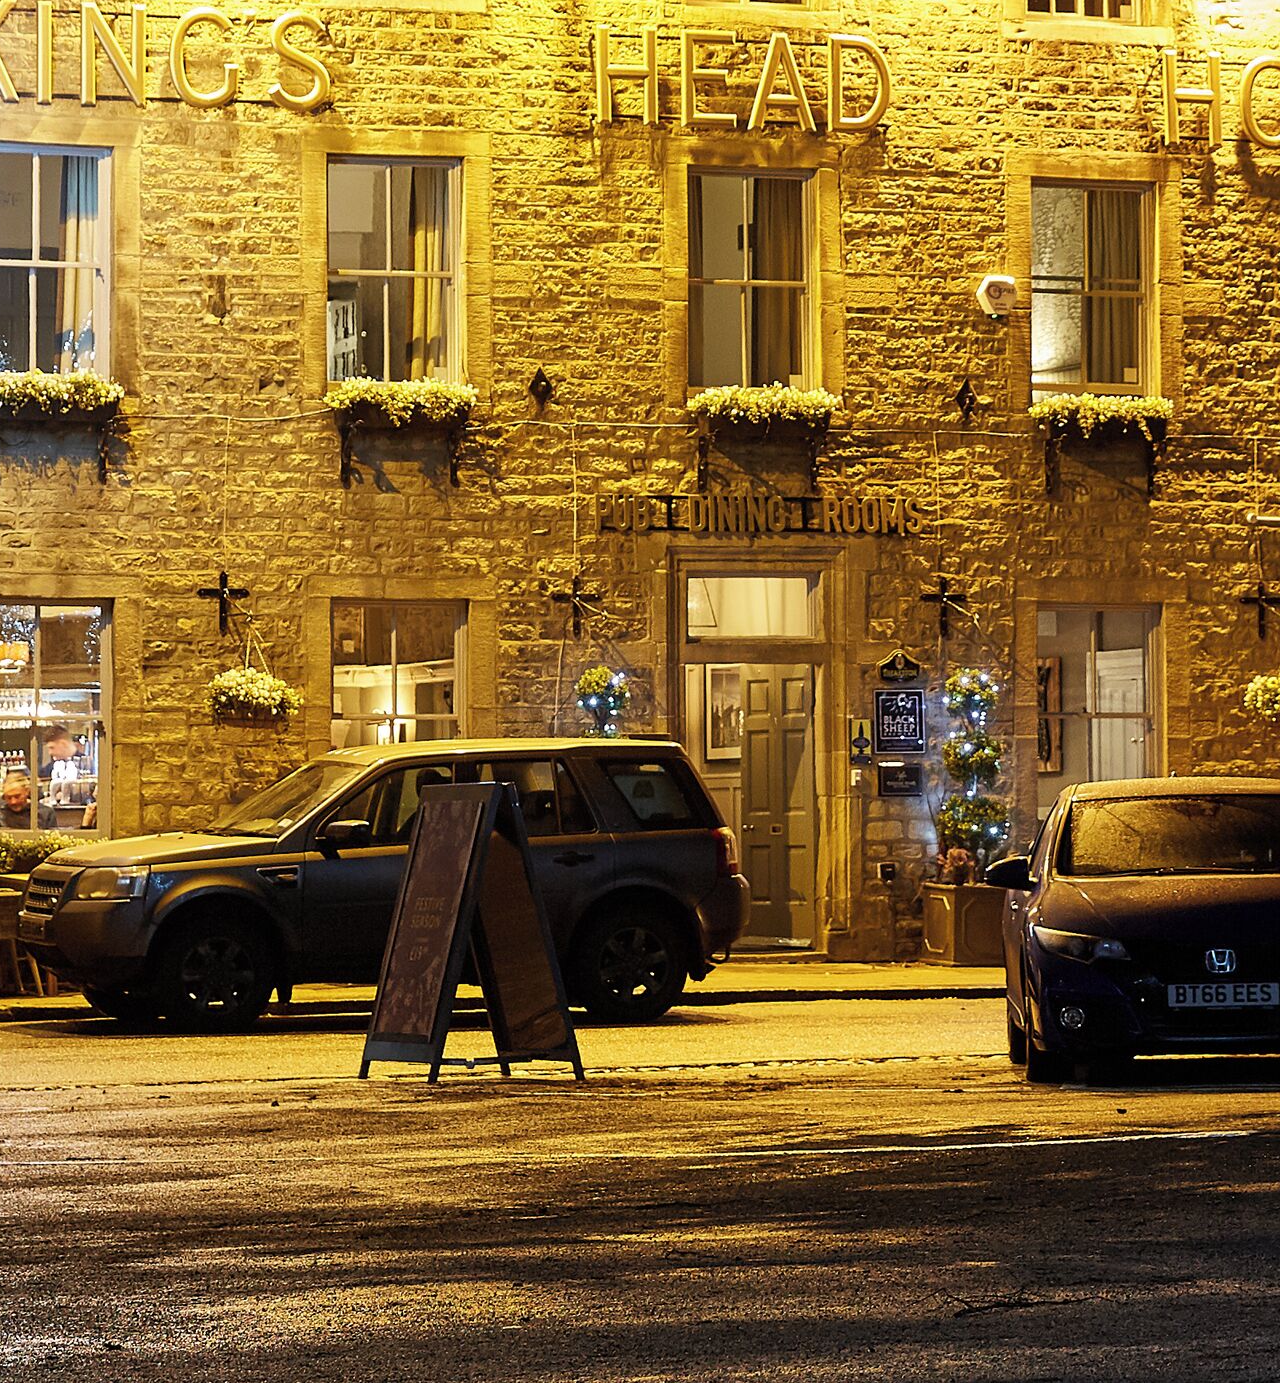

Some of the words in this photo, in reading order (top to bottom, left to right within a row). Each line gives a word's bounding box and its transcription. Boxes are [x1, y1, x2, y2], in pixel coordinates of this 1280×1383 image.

[594, 24, 892, 133] HEAD
[594, 493, 653, 532] PUB
[688, 494, 788, 533] DINING
[823, 496, 924, 534] ROOMS
[883, 715, 916, 724] BLACK
[883, 723, 916, 733] SHEEP
[1174, 984, 1228, 1004] BT66
[1232, 983, 1273, 1003] EES
